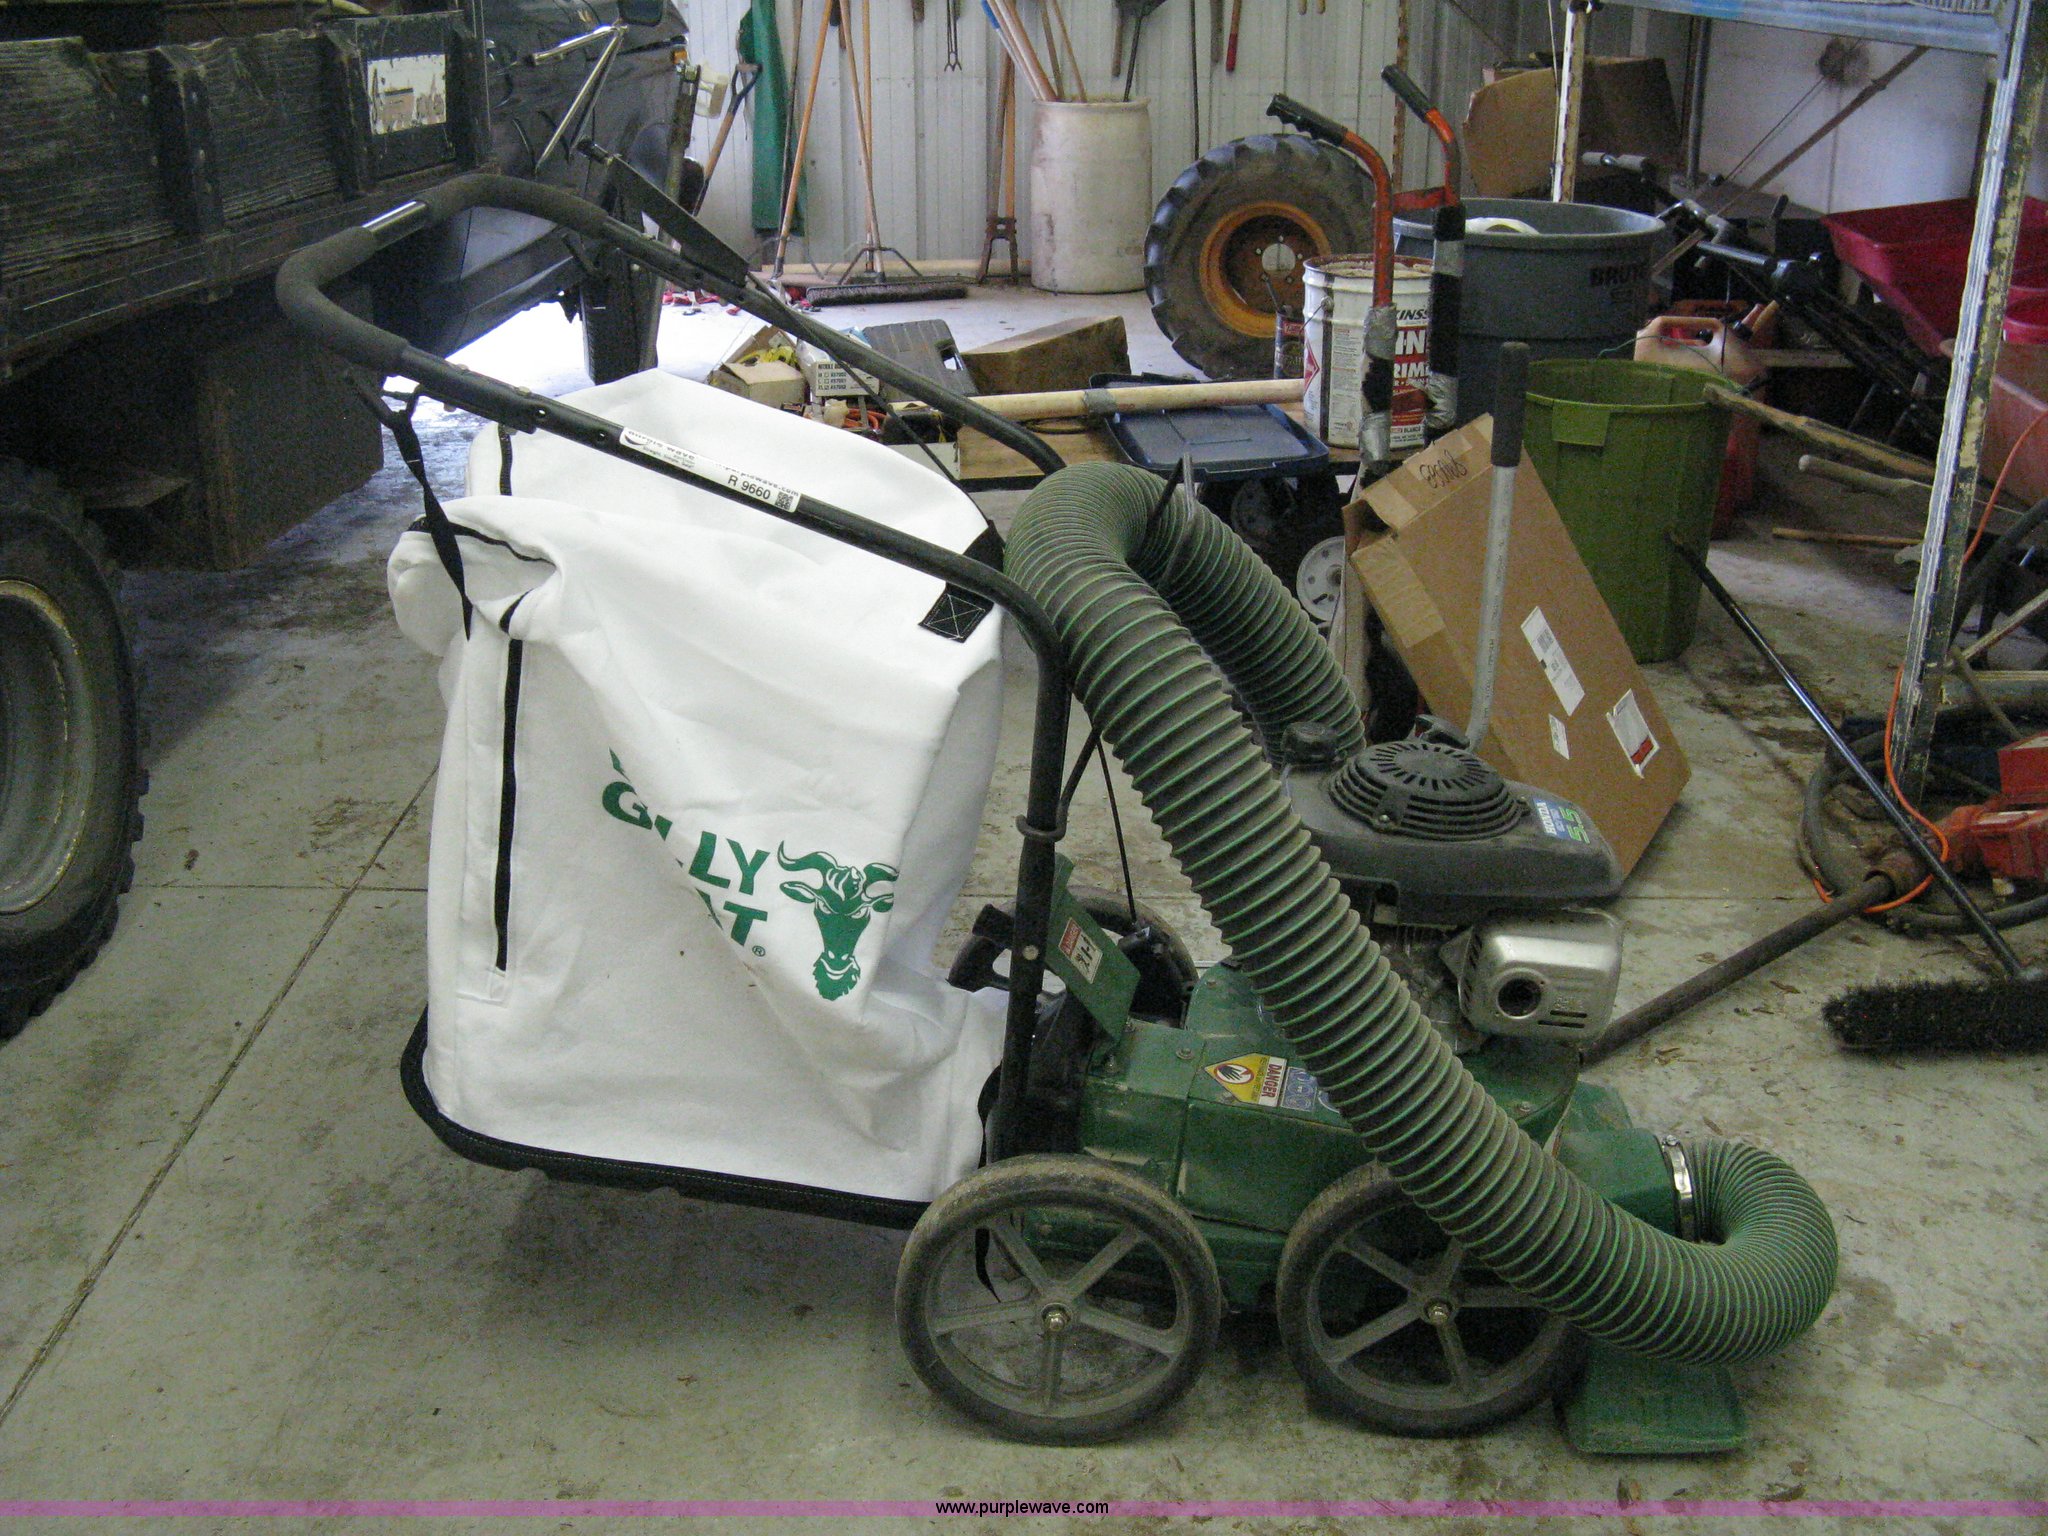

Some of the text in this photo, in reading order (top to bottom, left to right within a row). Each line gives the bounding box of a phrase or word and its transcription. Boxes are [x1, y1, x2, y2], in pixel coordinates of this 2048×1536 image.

[728, 474, 771, 500] R 9660
[1536, 802, 1557, 835] HONDA
[1261, 1063, 1283, 1098] DANGER
